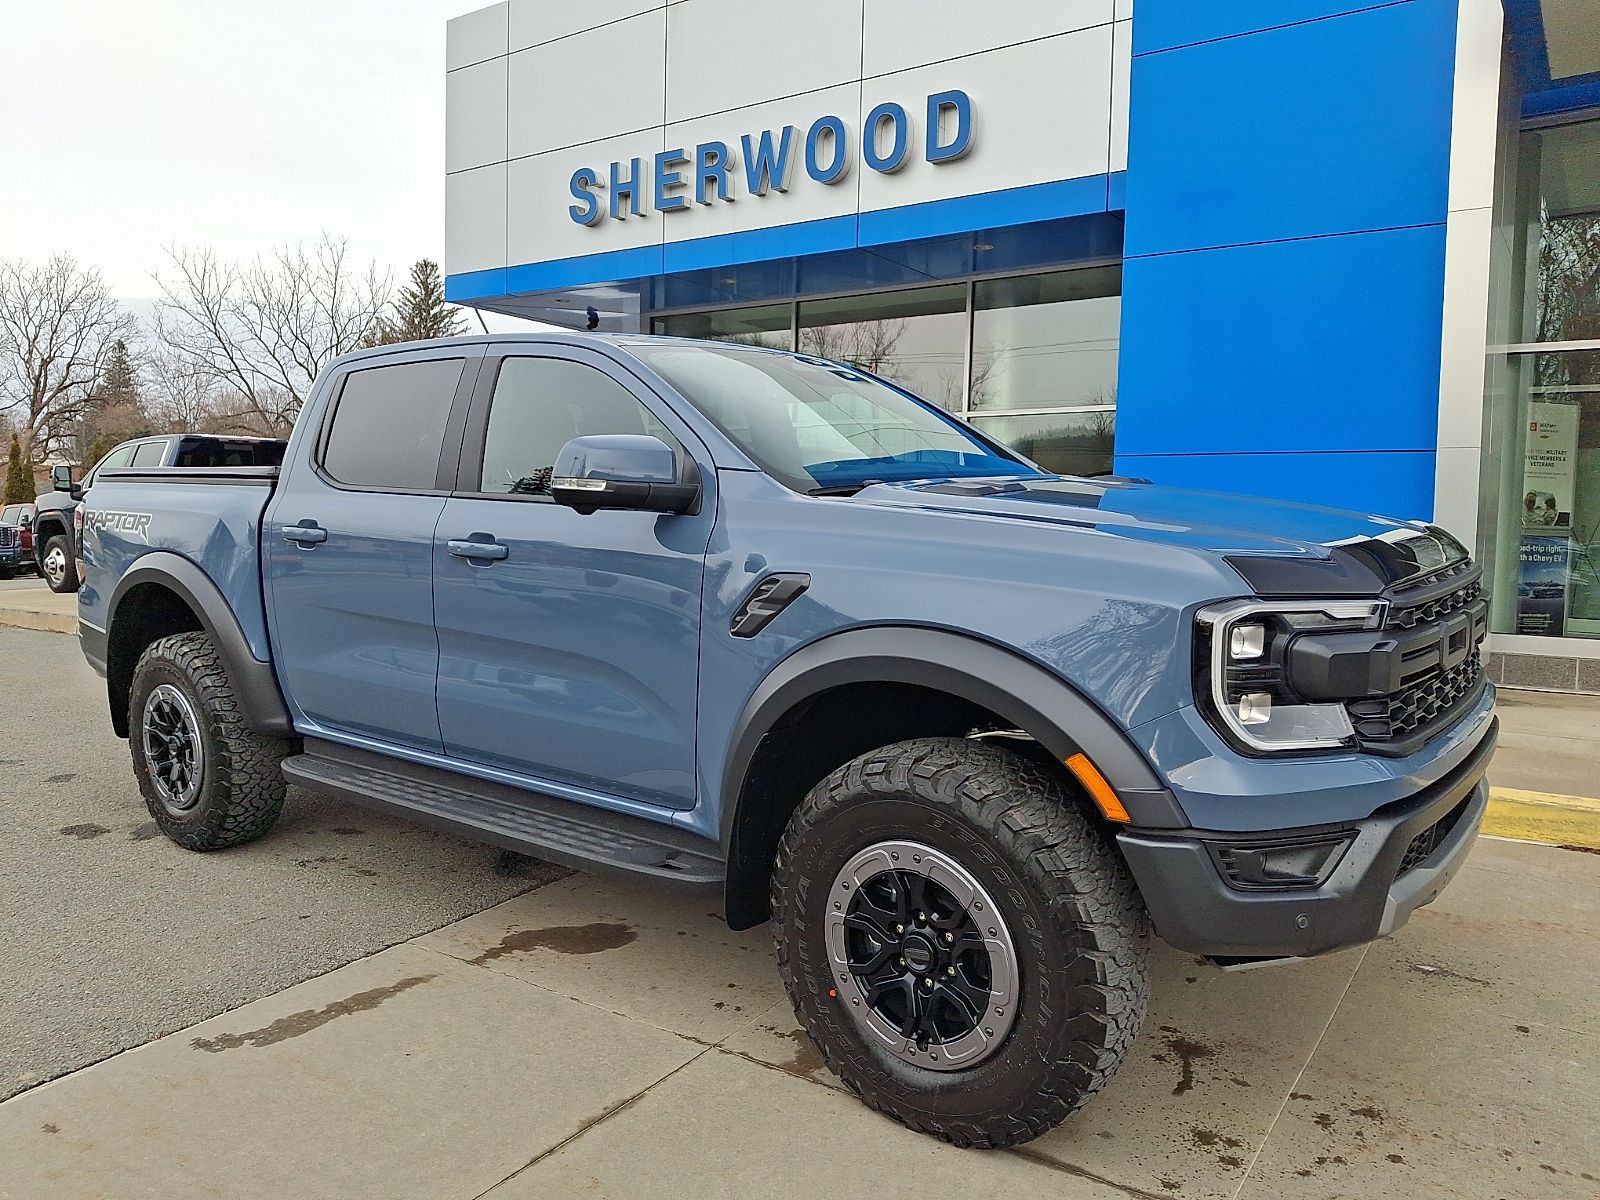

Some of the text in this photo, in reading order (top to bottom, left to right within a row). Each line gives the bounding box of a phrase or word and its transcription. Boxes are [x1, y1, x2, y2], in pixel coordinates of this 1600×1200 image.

[568, 89, 978, 228] SHERWOOD
[84, 510, 152, 546] RAPTOR
[1533, 553, 1553, 563] Chevy
[1545, 544, 1561, 554] right
